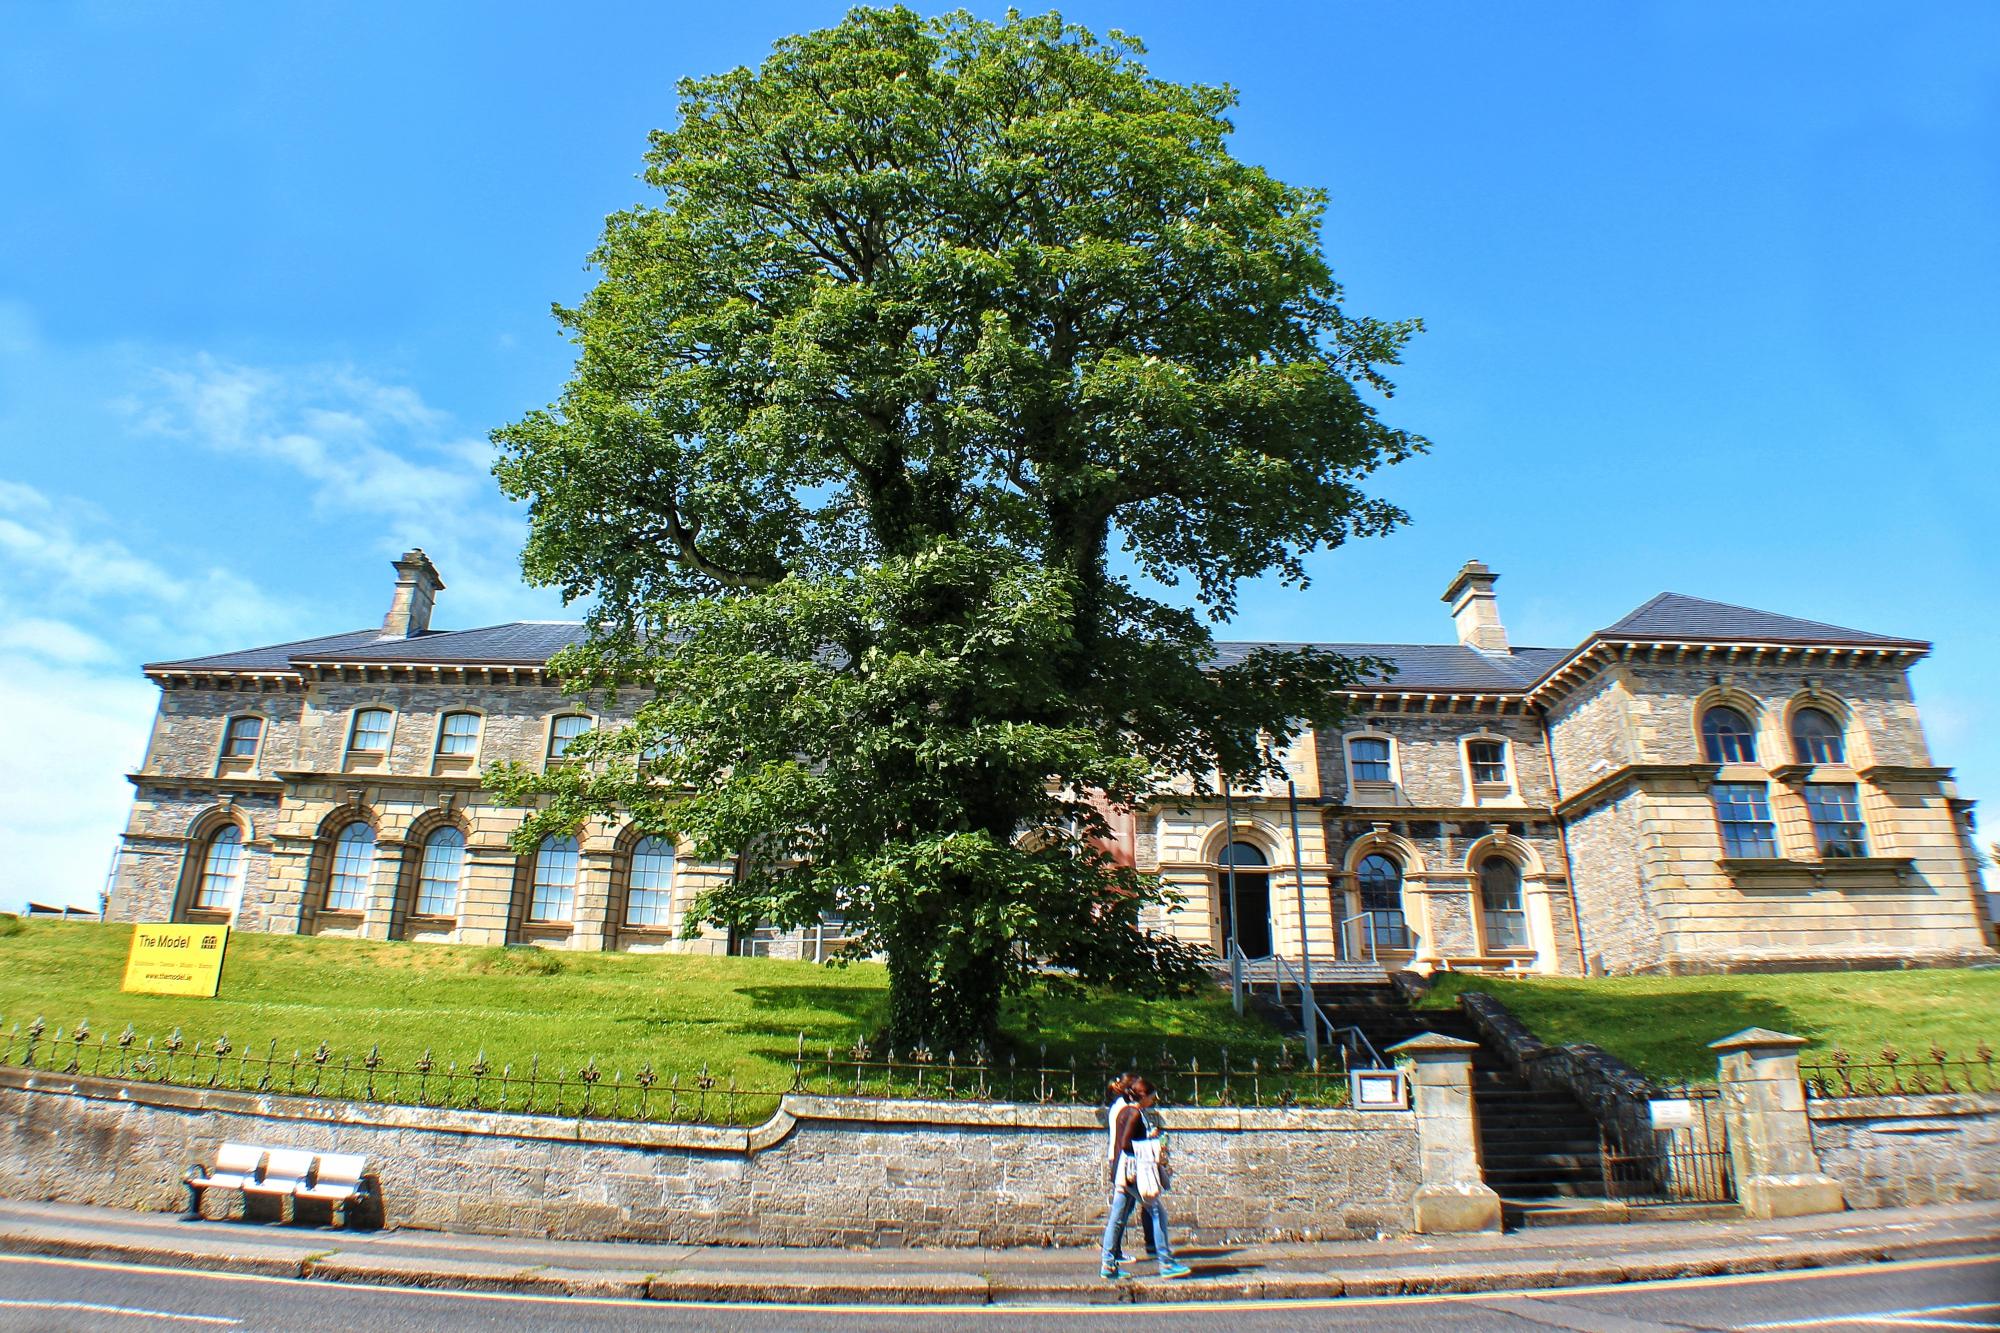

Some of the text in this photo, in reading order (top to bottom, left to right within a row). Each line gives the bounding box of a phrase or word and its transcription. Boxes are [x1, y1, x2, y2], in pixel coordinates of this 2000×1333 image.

[139, 935, 191, 949] The Model
[145, 972, 193, 981] www.themodel.ie
